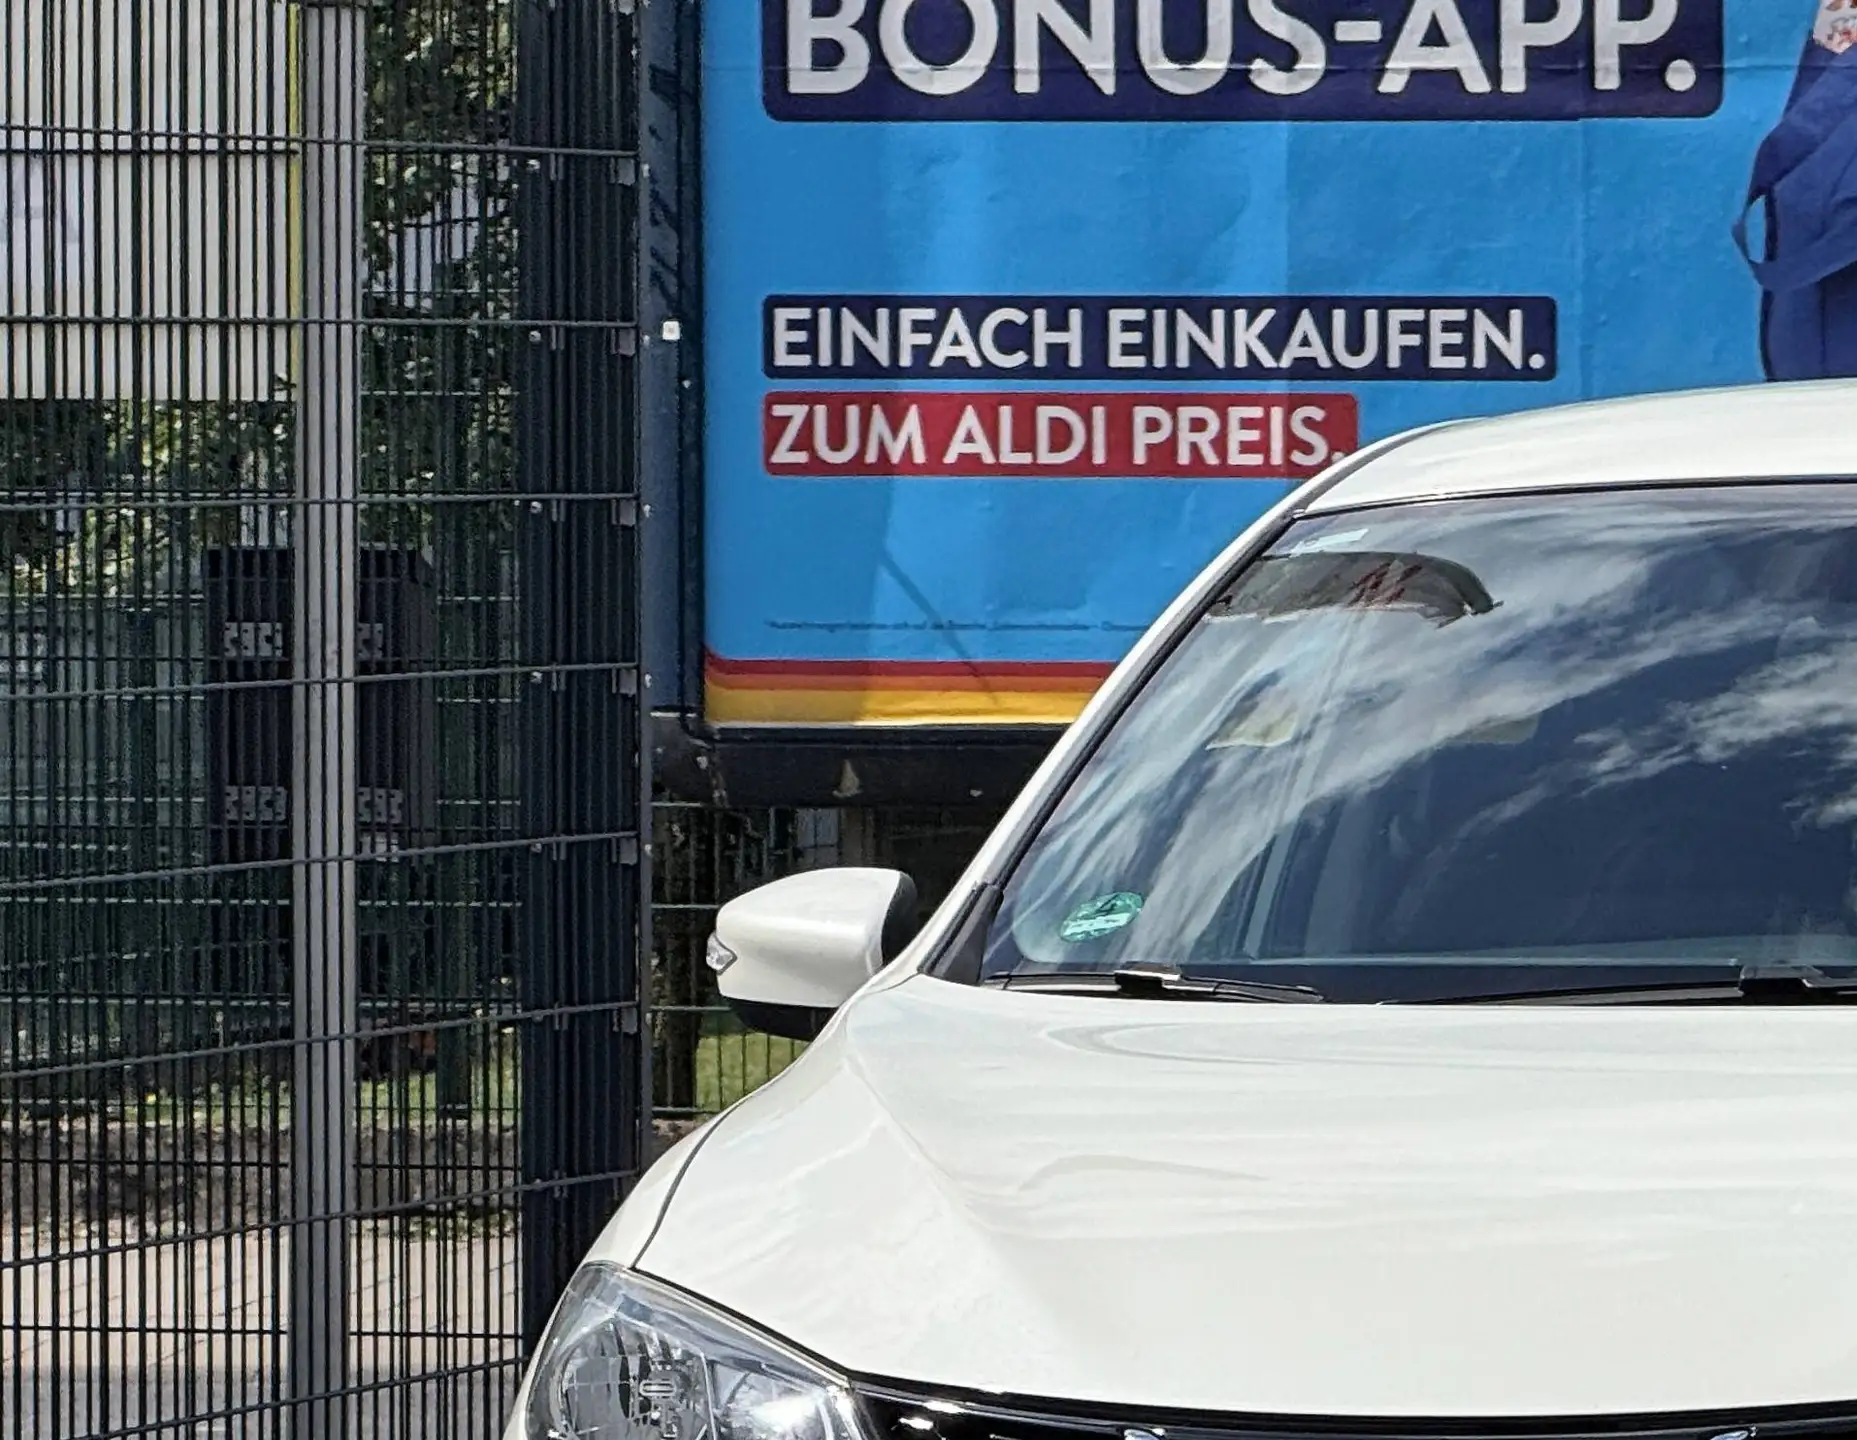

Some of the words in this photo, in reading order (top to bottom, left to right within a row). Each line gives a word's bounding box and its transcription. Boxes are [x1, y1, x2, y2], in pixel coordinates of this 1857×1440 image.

[786, 0, 1697, 96] BONUS-APP.
[773, 307, 1083, 370] EINFACH
[1108, 307, 1547, 370] EINKAUFEN.
[769, 404, 926, 466] ZUM
[943, 404, 1107, 465] ALDI
